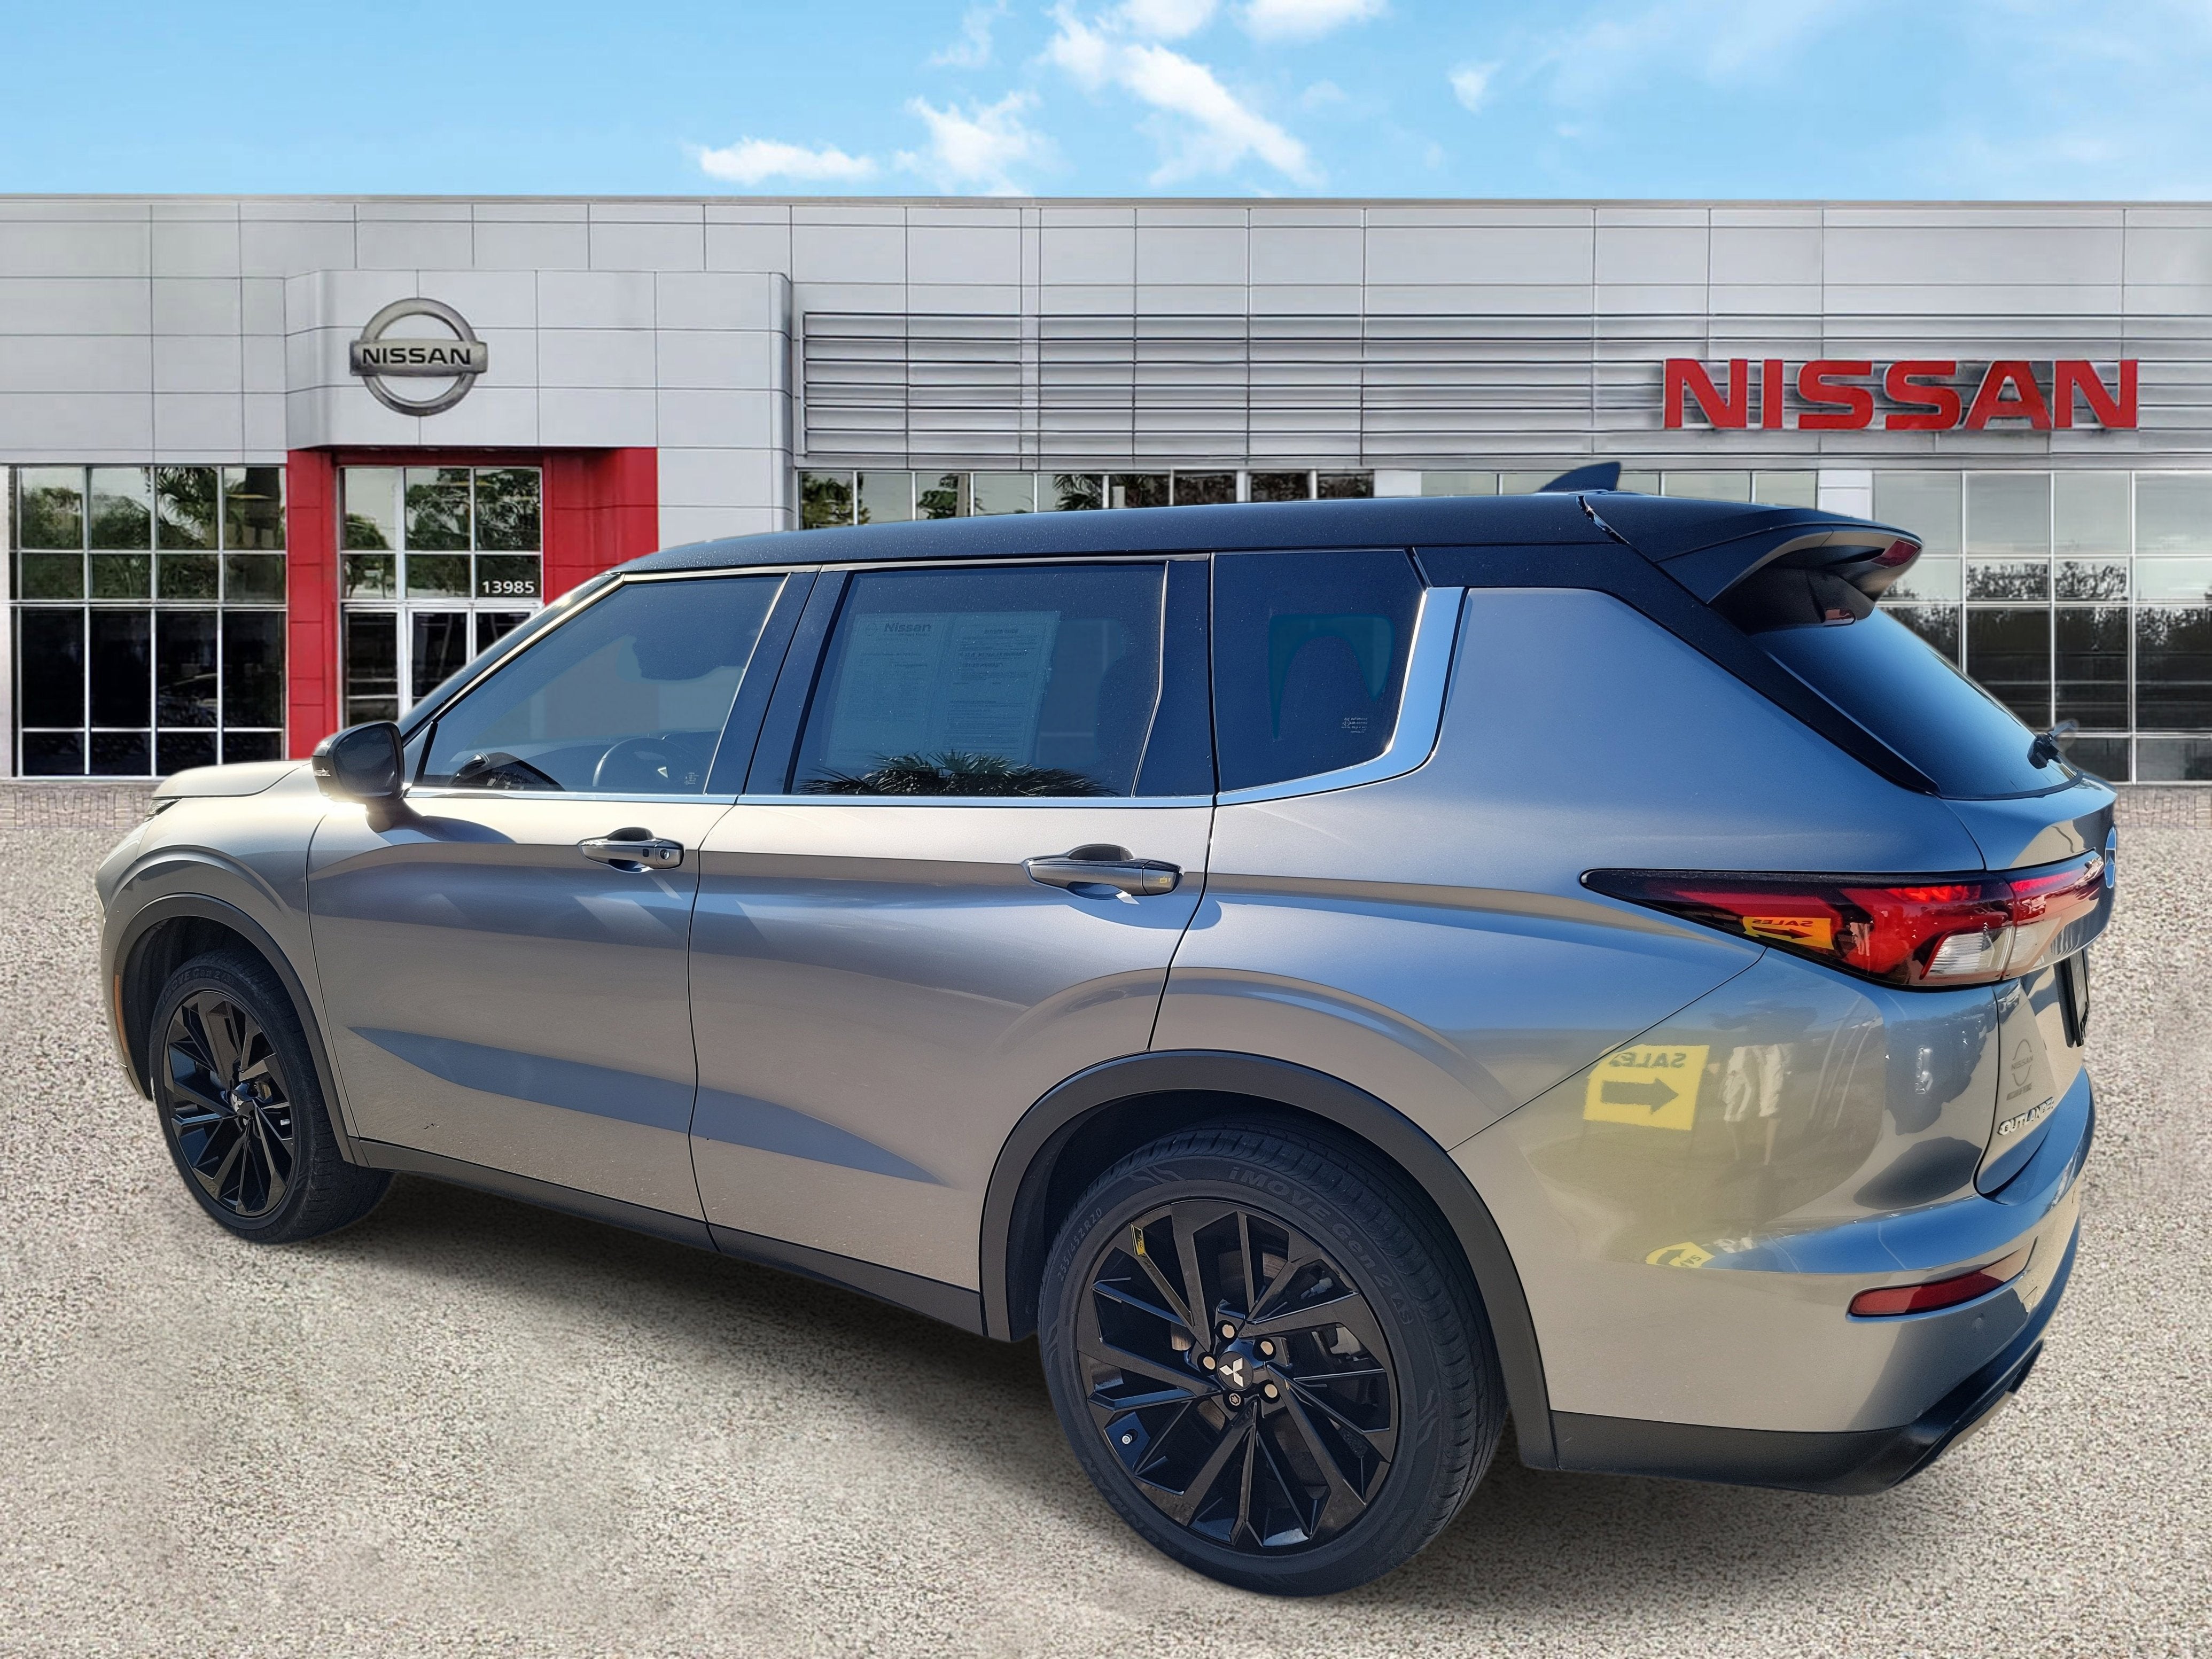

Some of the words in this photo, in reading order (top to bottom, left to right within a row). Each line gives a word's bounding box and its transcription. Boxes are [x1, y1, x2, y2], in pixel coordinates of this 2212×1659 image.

[363, 348, 471, 365] NISSAN
[1664, 358, 2138, 431] NISSAN
[482, 580, 534, 594] 13985
[884, 622, 931, 633] Nissan
[1229, 1167, 1330, 1222] iMOVE
[1333, 1223, 1375, 1268] Gen
